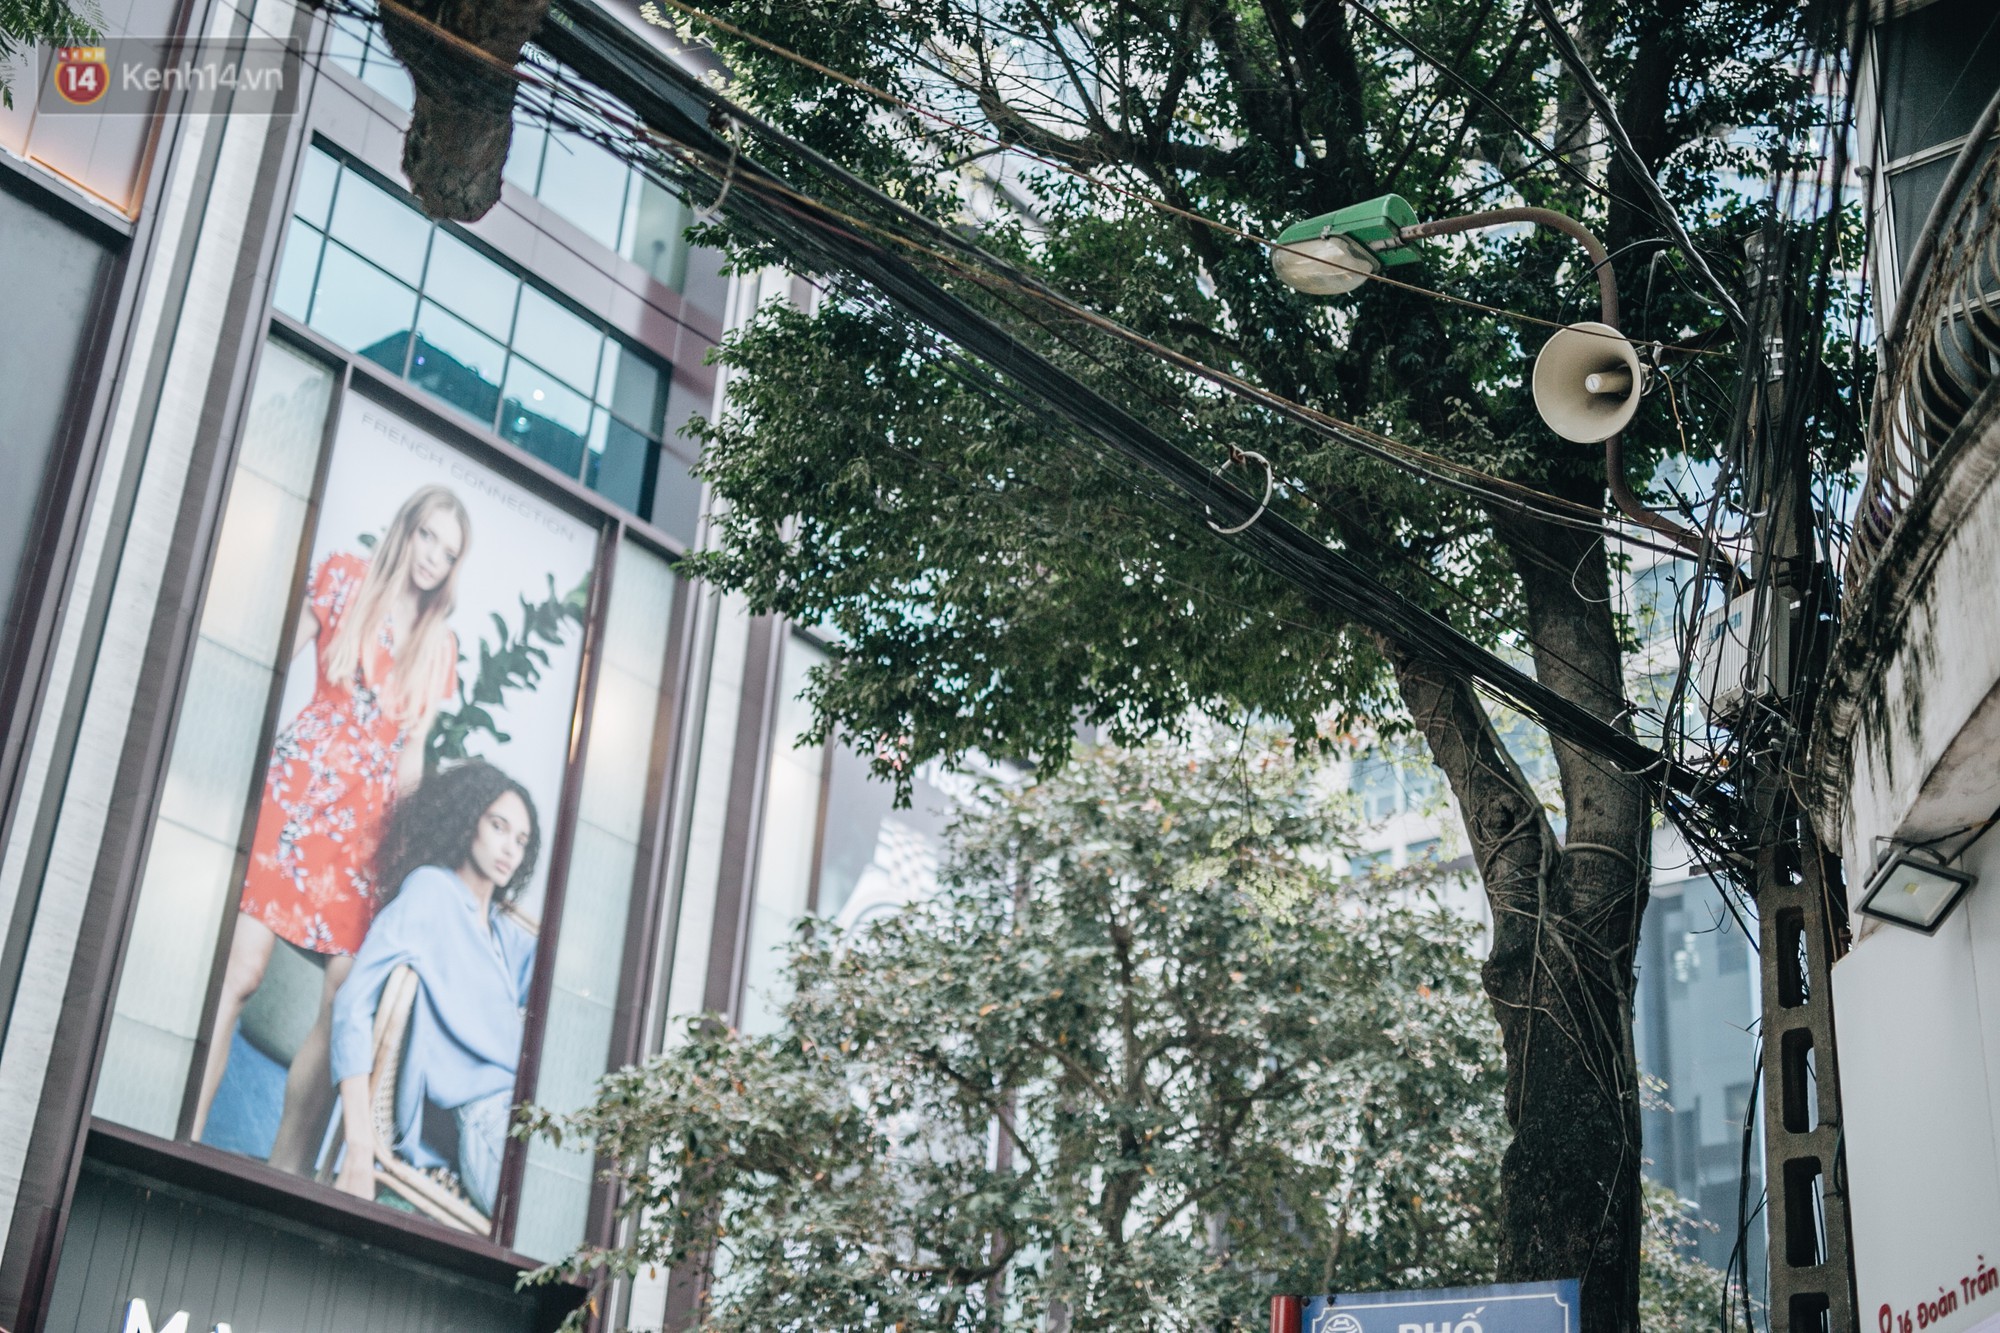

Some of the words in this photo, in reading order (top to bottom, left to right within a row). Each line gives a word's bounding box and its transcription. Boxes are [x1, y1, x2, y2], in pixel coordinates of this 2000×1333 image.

[361, 411, 443, 468] FRENCH
[450, 461, 575, 543] CONNECTION
[1917, 1286, 1958, 1330] Đoàn
